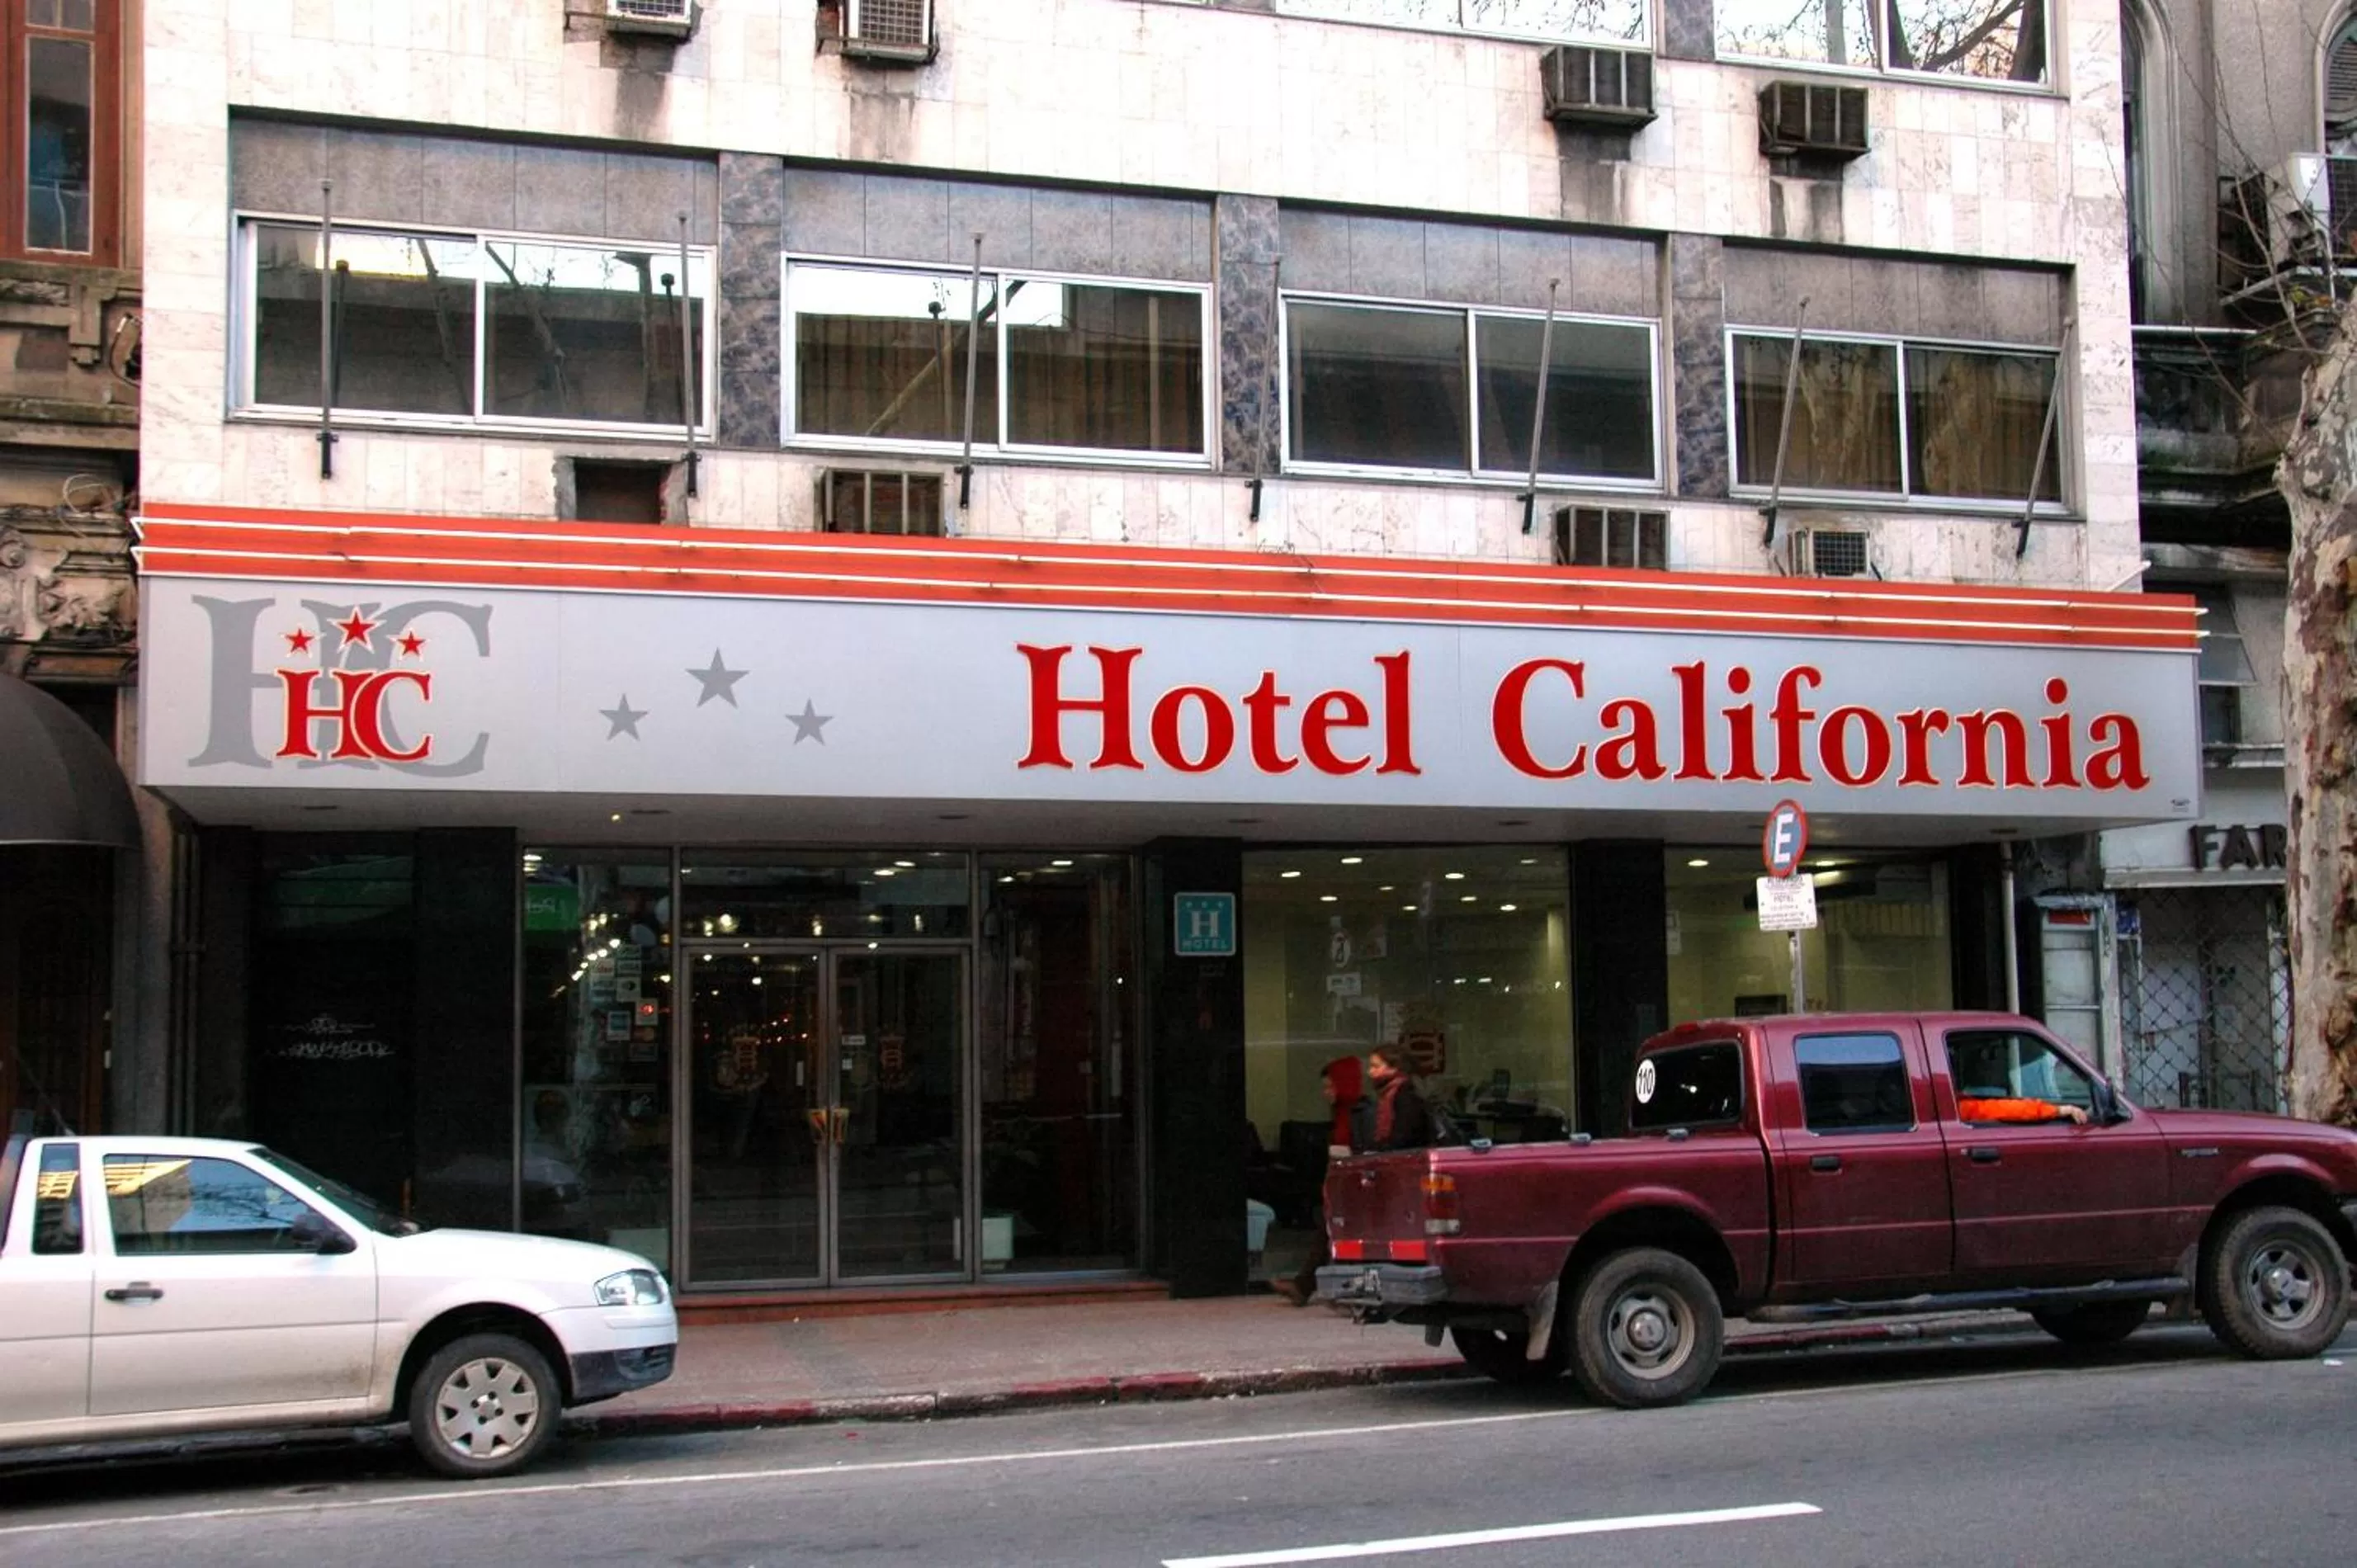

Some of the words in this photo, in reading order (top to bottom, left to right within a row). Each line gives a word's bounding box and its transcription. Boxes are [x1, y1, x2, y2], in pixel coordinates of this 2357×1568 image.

[187, 593, 494, 777] HC
[275, 668, 433, 763] HC
[1016, 642, 1422, 776] Hotel
[1491, 657, 2150, 792] California
[1774, 812, 1795, 864] E
[1181, 939, 1229, 952] HOTEL
[1191, 910, 1220, 937] H
[1638, 1068, 1654, 1094] 110
